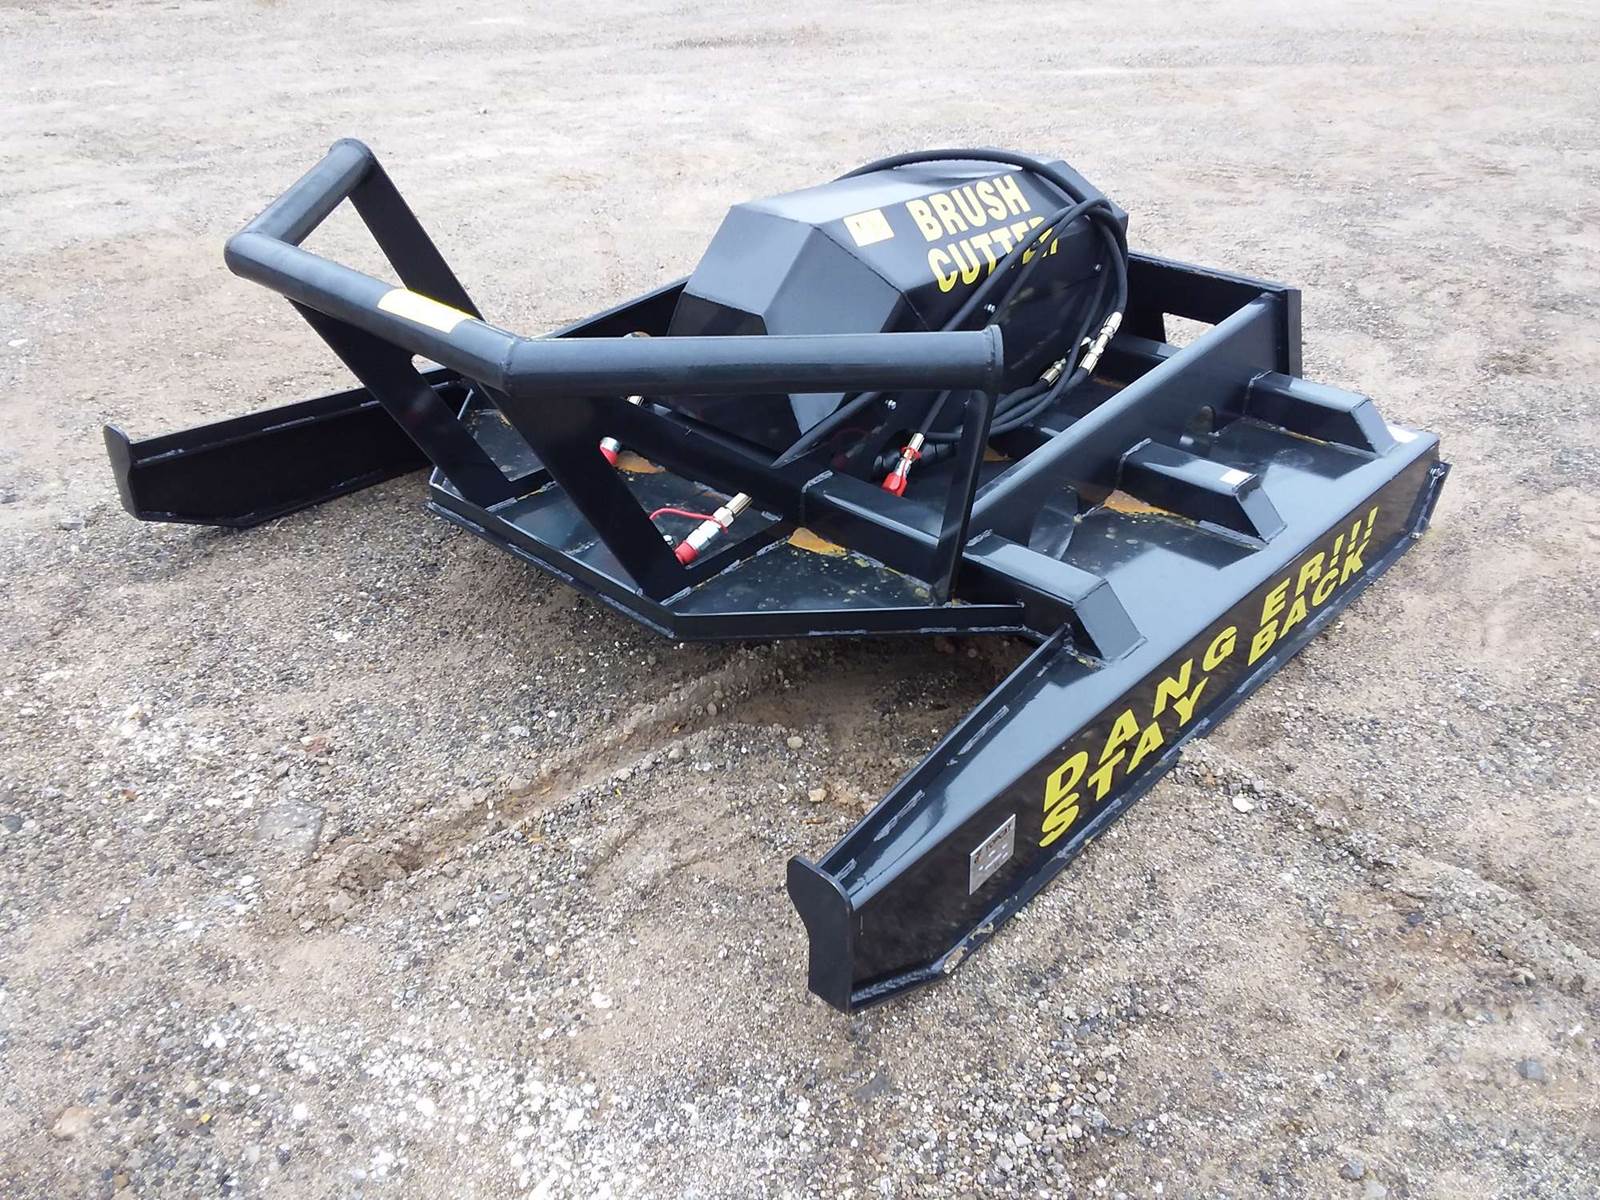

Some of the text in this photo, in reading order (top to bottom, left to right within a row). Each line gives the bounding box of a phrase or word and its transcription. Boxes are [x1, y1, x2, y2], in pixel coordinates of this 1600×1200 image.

[905, 175, 1031, 242] BRUSH
[1038, 540, 1370, 847] STAY BACK
